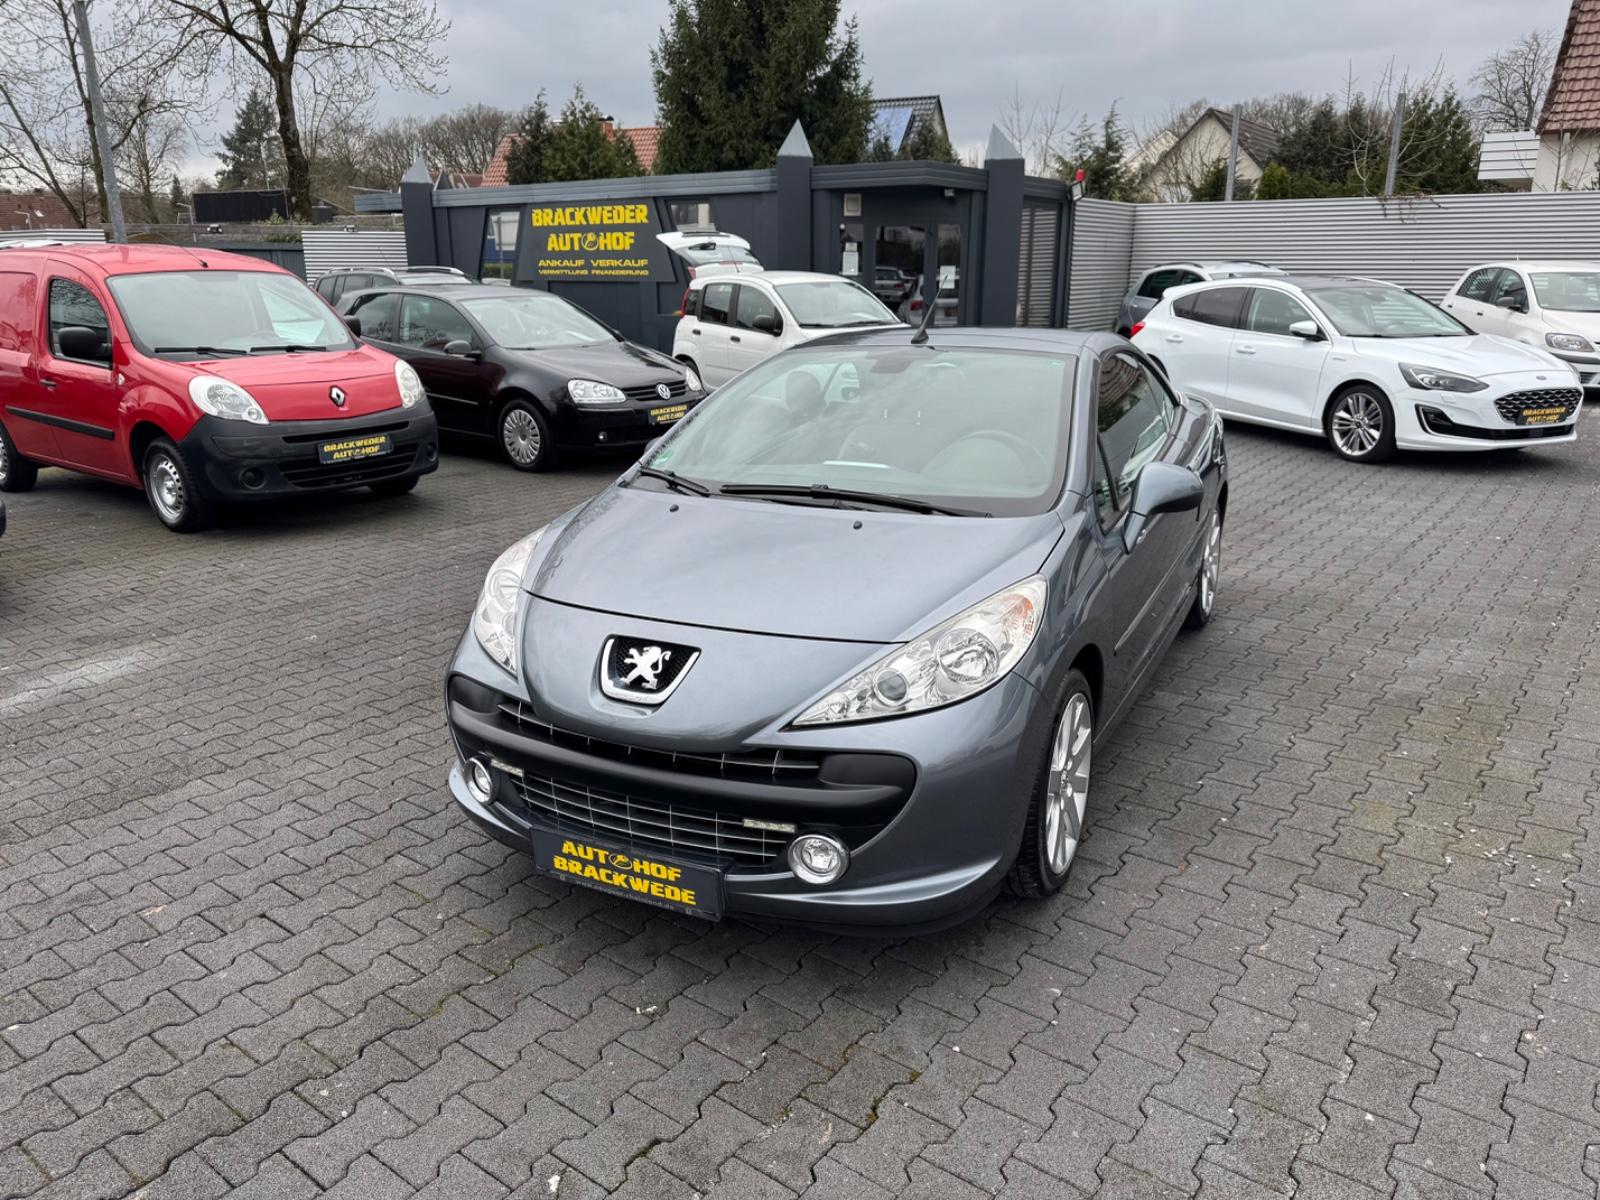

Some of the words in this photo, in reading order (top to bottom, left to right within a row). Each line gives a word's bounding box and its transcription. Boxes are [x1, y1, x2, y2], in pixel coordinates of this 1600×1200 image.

[531, 204, 648, 227] BRACKWEDER
[538, 259, 585, 267] ANKAUF
[591, 259, 649, 267] VERKAUF
[323, 436, 386, 452] BRACKWEDER
[553, 855, 697, 906] BRACKWEDE
